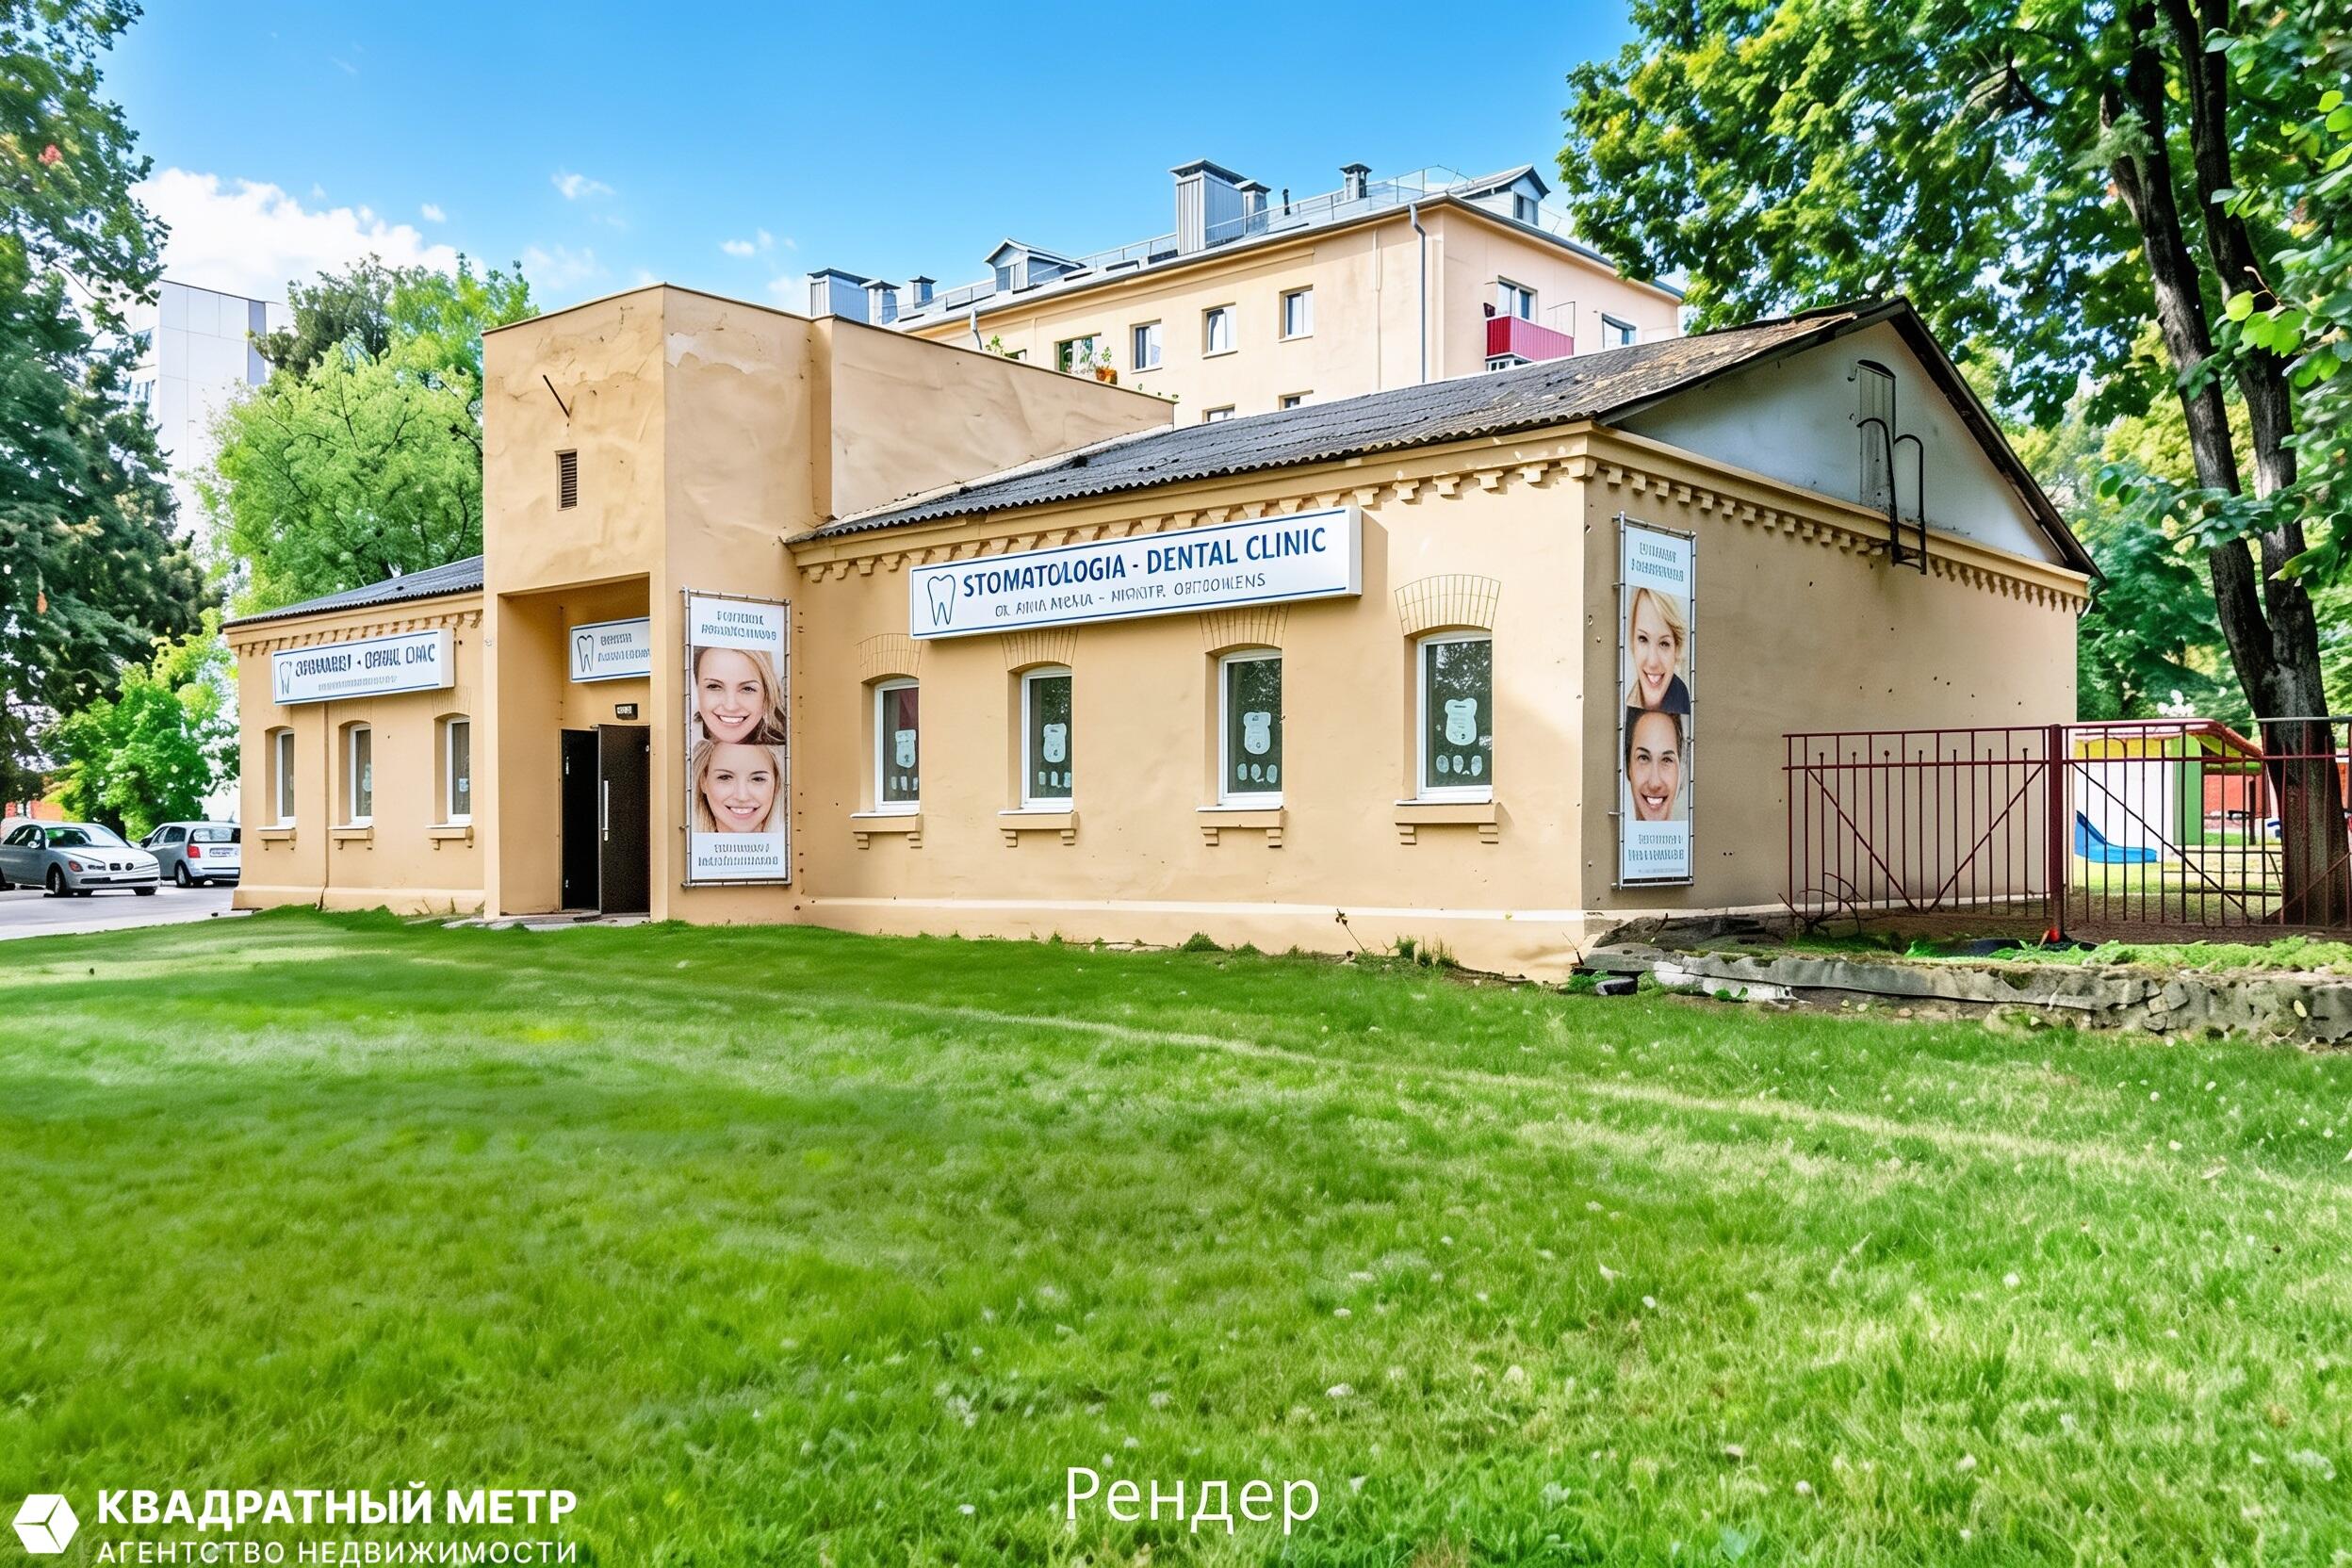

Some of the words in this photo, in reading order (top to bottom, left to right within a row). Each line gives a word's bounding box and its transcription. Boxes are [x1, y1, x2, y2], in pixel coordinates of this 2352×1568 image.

[963, 554, 1127, 598] STOMATOLOGIA
[1147, 539, 1239, 575] DENTAL
[1246, 527, 1327, 561] CLINIC
